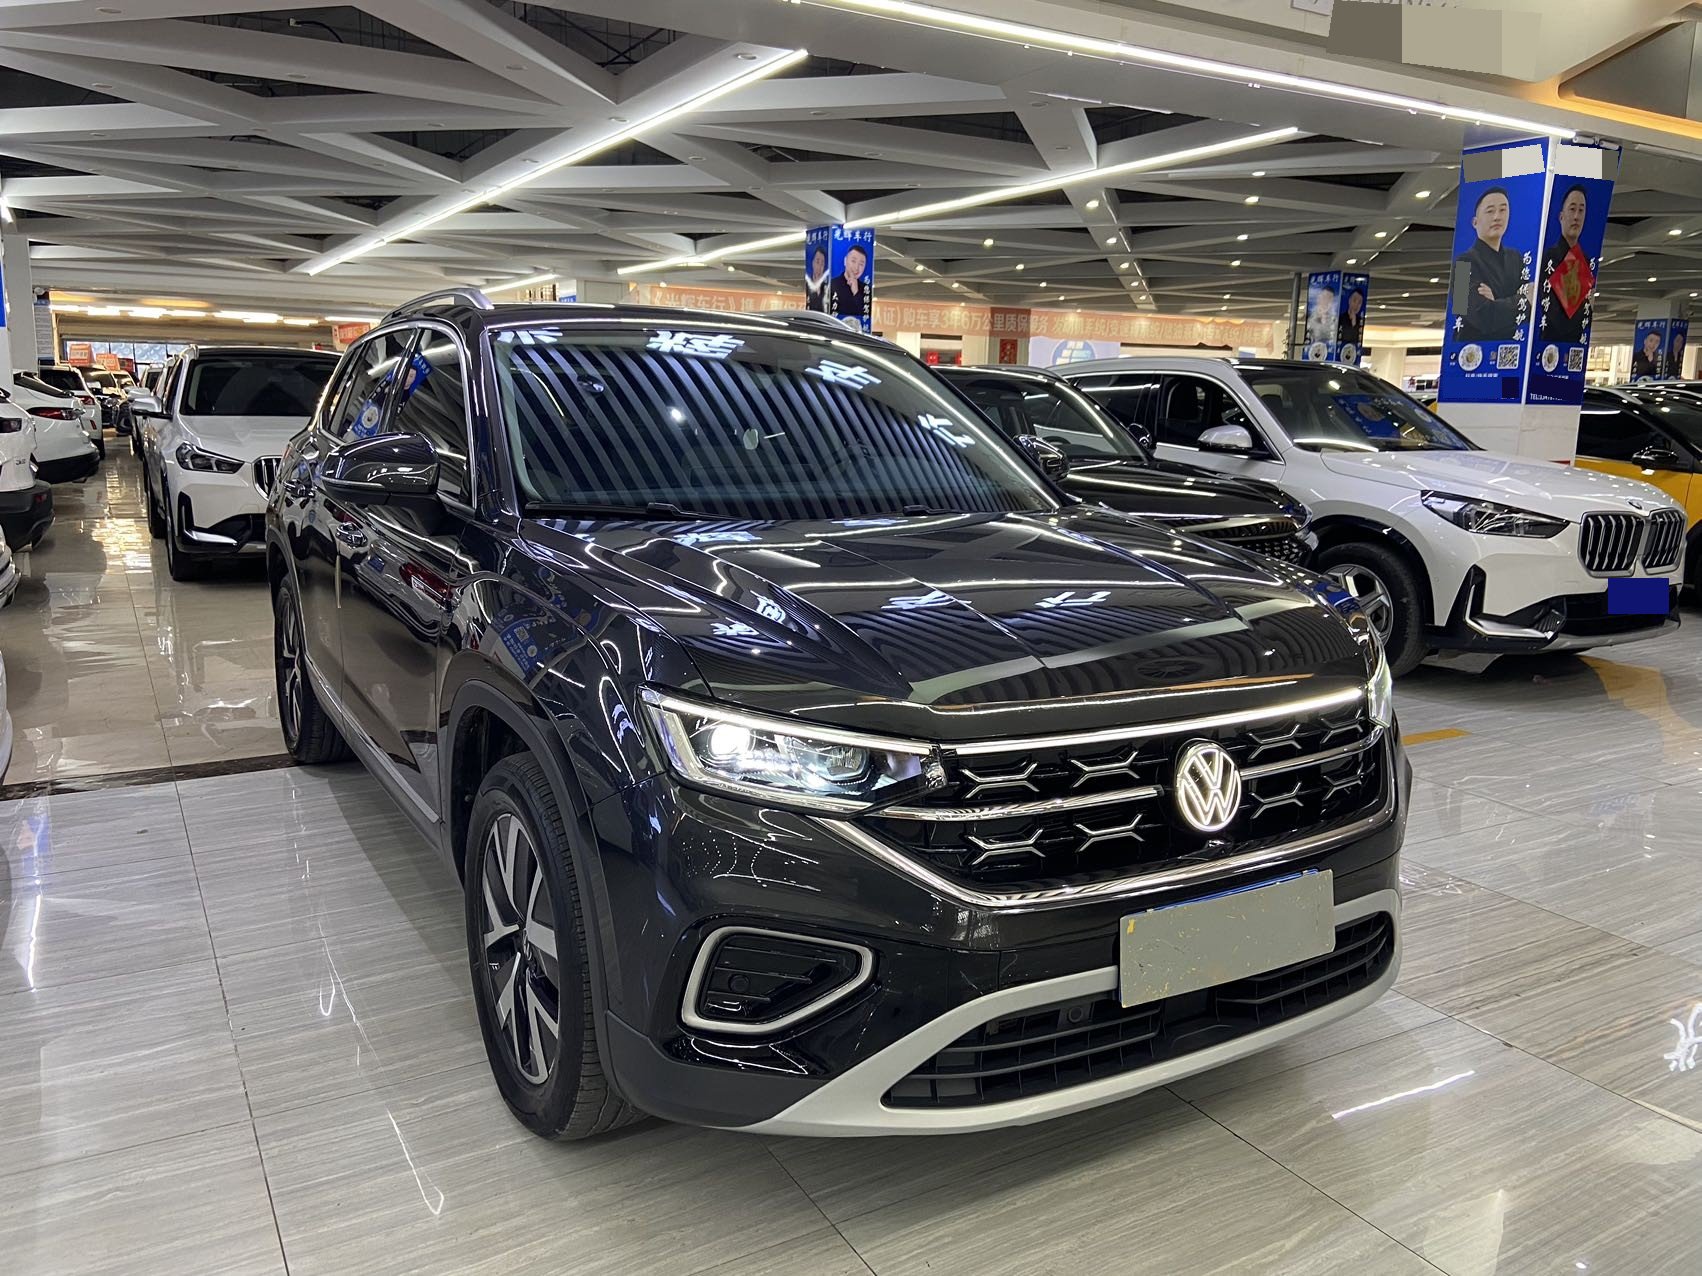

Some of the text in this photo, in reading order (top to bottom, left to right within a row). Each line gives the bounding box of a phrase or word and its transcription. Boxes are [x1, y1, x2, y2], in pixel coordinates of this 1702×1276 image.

[1513, 250, 1532, 342] 为您保驾护航
